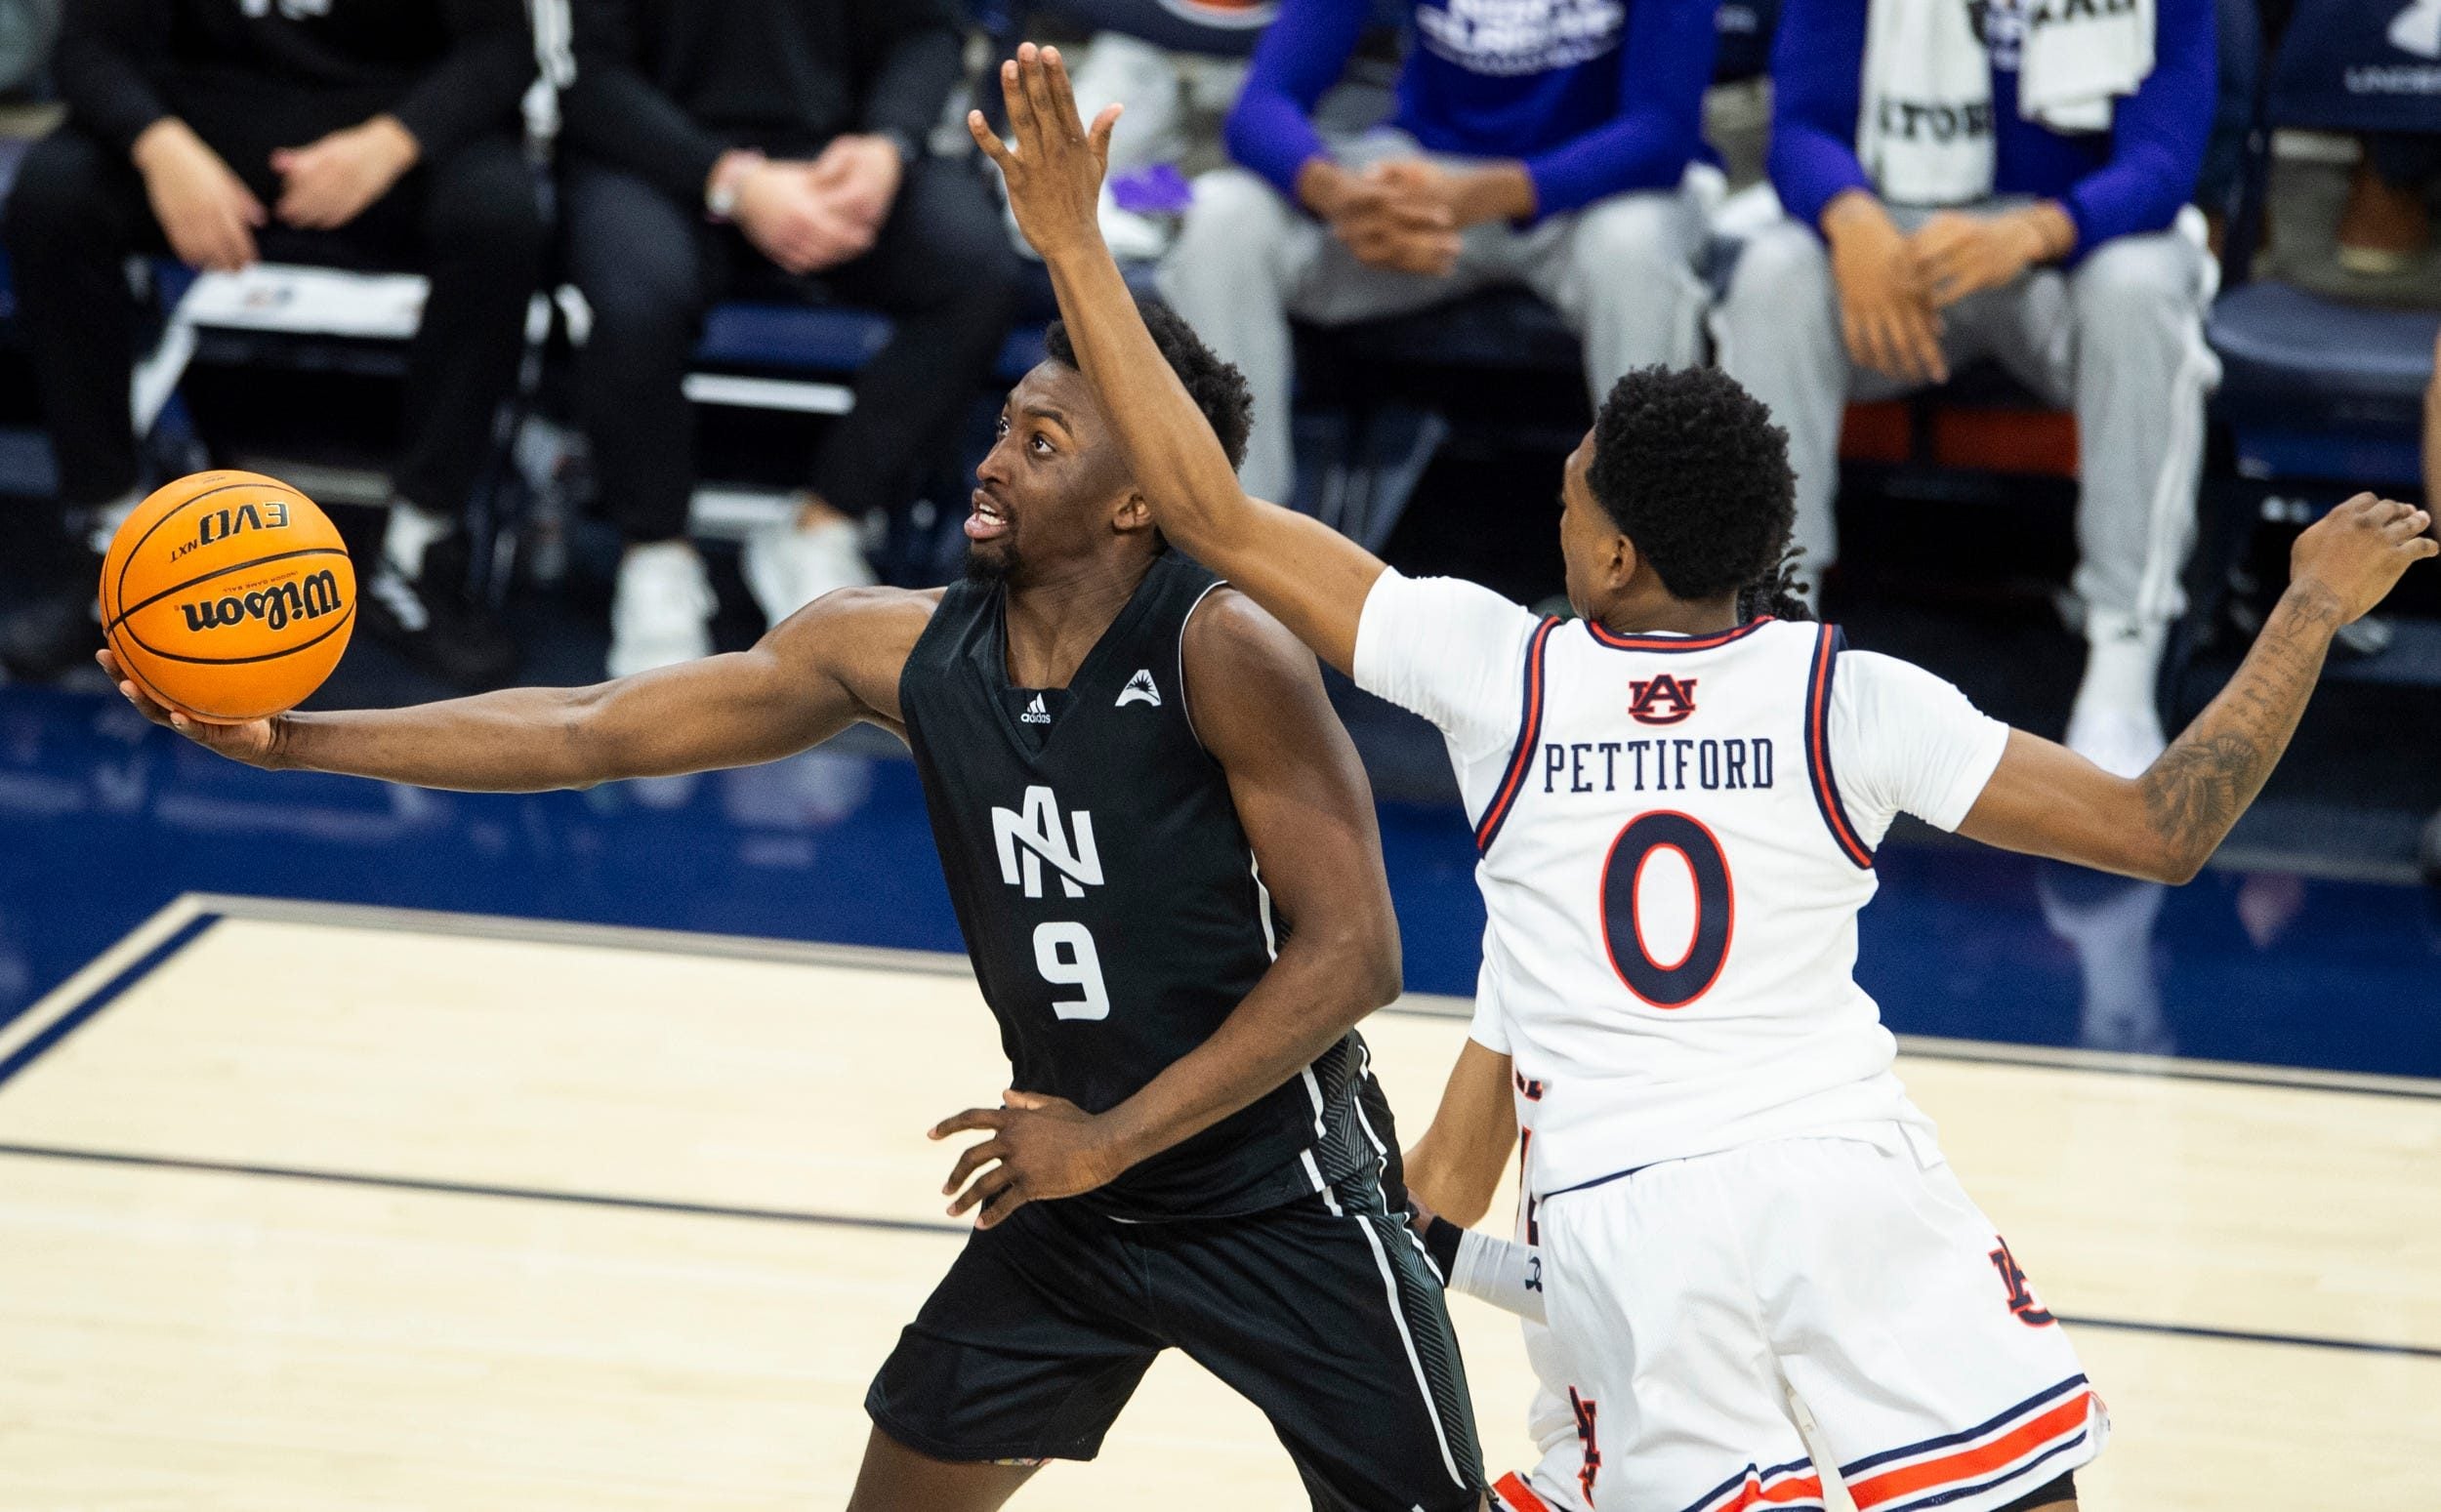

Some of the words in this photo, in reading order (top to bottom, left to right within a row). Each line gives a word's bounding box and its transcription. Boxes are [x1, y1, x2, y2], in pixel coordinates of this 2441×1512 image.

[169, 539, 198, 563] NXT
[199, 501, 290, 546] EVO
[181, 569, 343, 633] Wilson
[1020, 712, 1051, 724] adidas
[1544, 738, 1773, 793] PETTIFORD
[1599, 809, 1734, 1009] 0
[1032, 920, 1110, 1022] 9
